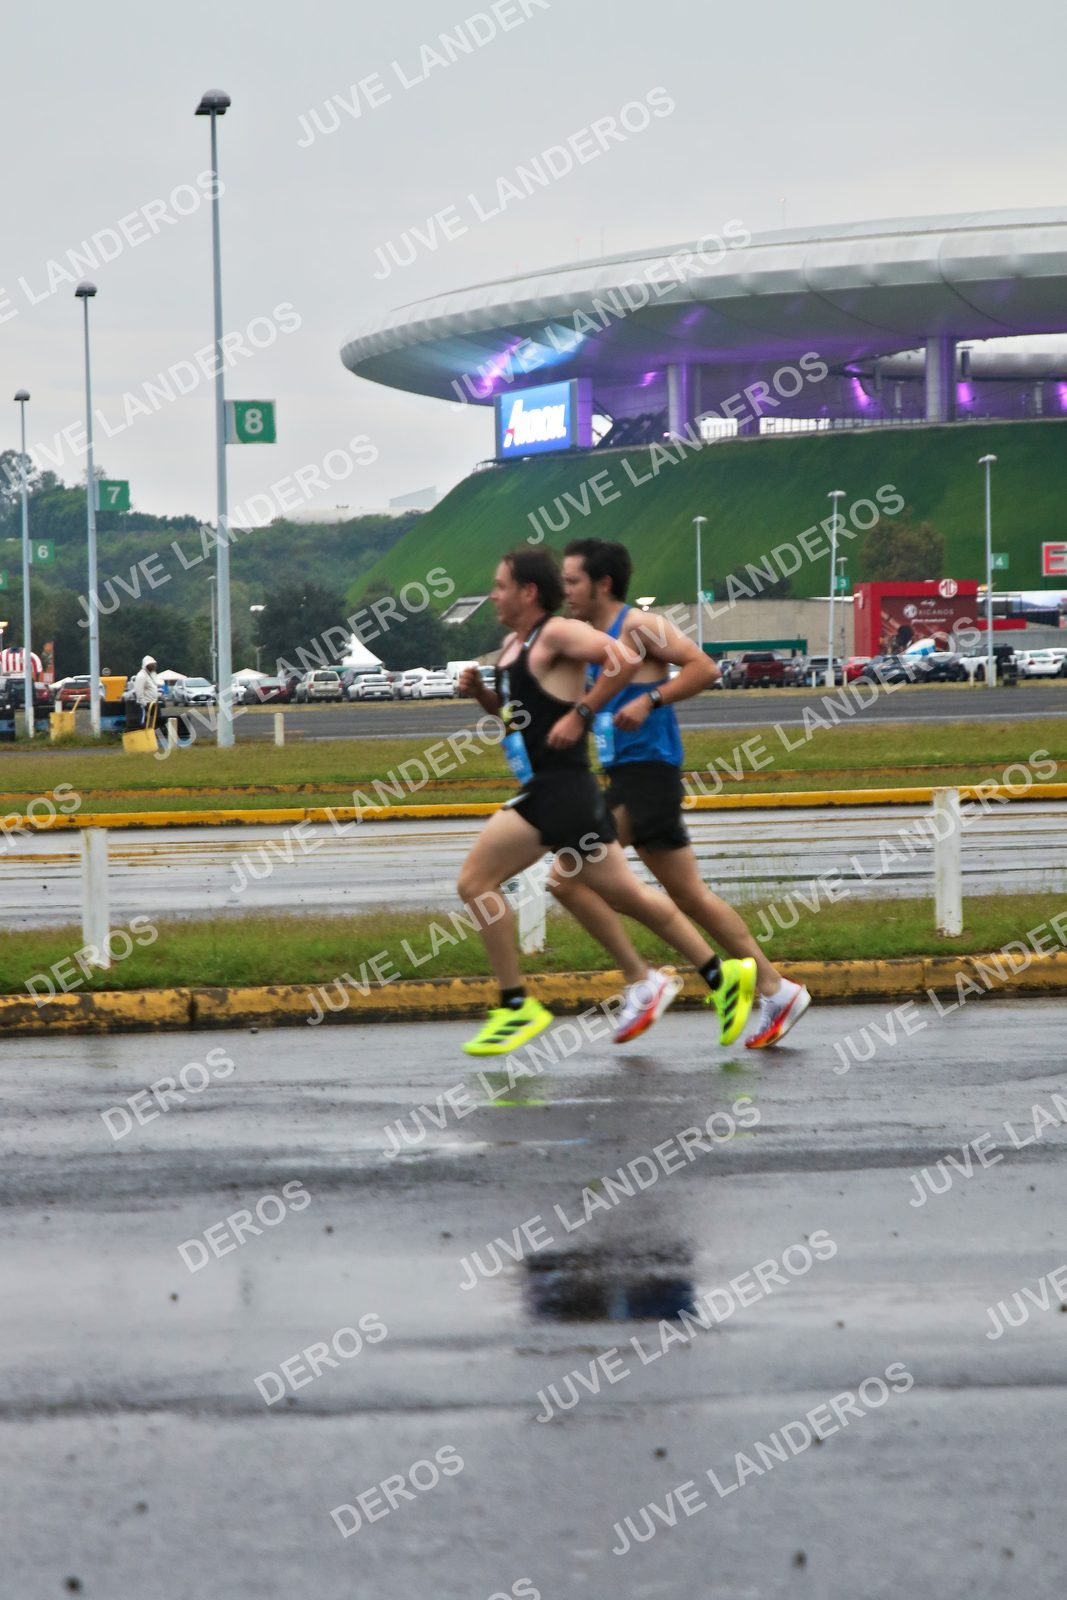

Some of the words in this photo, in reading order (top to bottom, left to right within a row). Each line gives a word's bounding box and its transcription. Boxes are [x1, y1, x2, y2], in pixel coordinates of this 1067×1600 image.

[244, 408, 263, 434] 8
[107, 486, 121, 504] 7
[38, 544, 48, 559] 6
[995, 556, 1004, 567] 4
